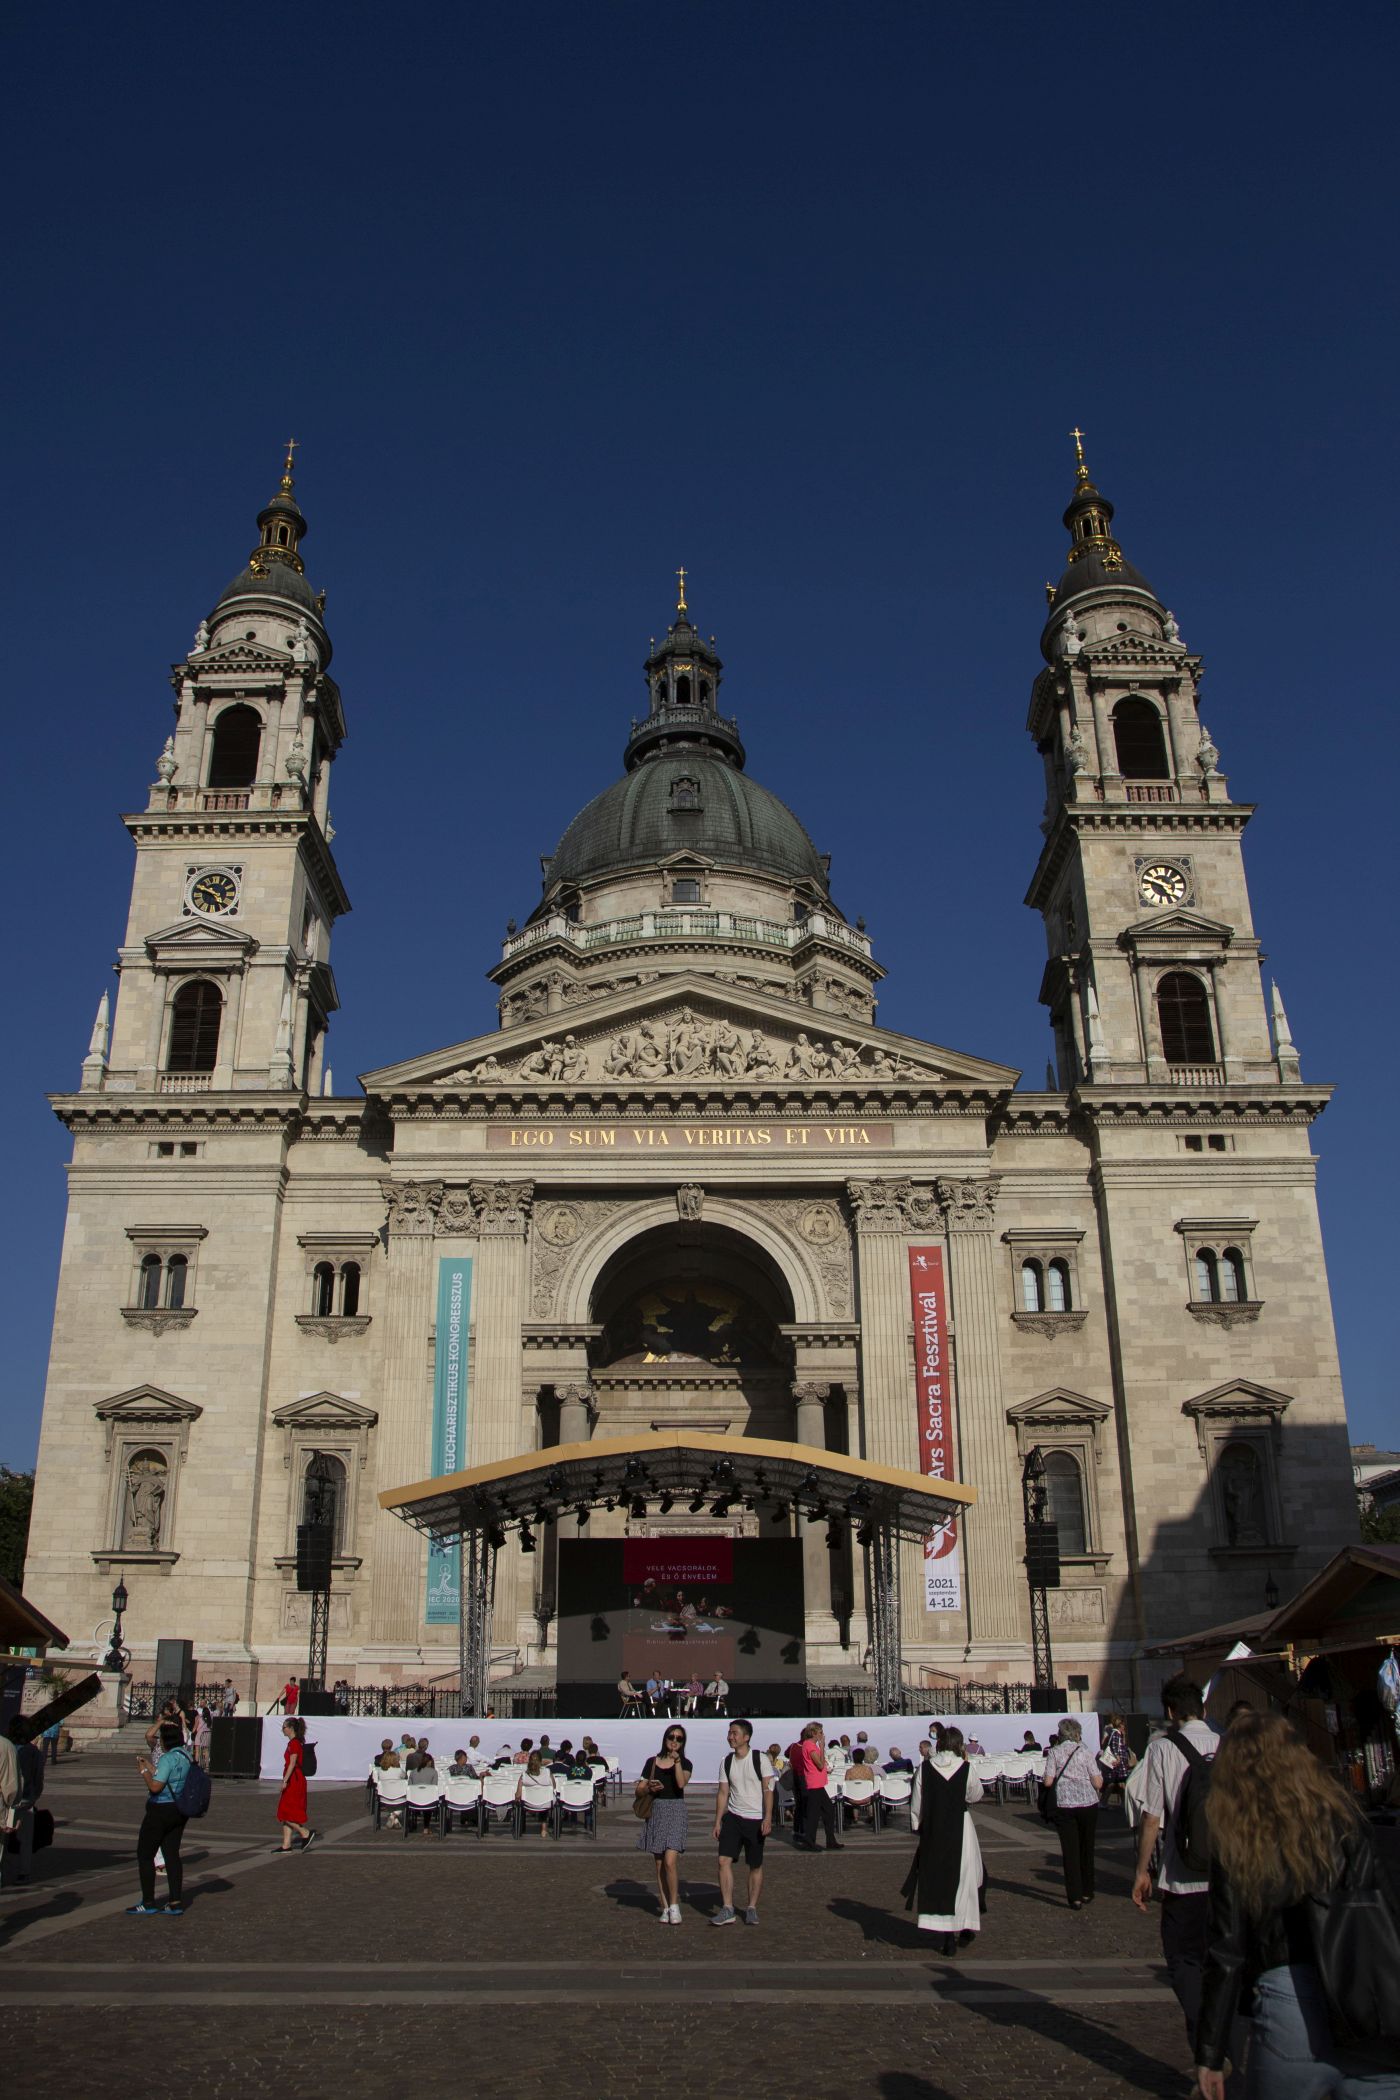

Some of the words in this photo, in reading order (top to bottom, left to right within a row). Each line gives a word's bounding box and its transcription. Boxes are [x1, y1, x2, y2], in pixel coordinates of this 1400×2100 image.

[510, 1130, 554, 1146] EGO
[569, 1130, 616, 1146] SUM
[634, 1130, 670, 1146] VIA
[684, 1128, 772, 1145] VERITAS
[785, 1128, 810, 1144] ET
[824, 1128, 871, 1144] VITA
[448, 1272, 463, 1361] KONGRESSZUS
[919, 1291, 940, 1378] Fesztivál
[444, 1363, 459, 1470] EUCHARISZTIKUS
[925, 1384, 943, 1441] Sacra
[927, 1448, 945, 1481] Ars
[927, 1578, 958, 1588] 2021.
[928, 1597, 958, 1608] 4-12.
